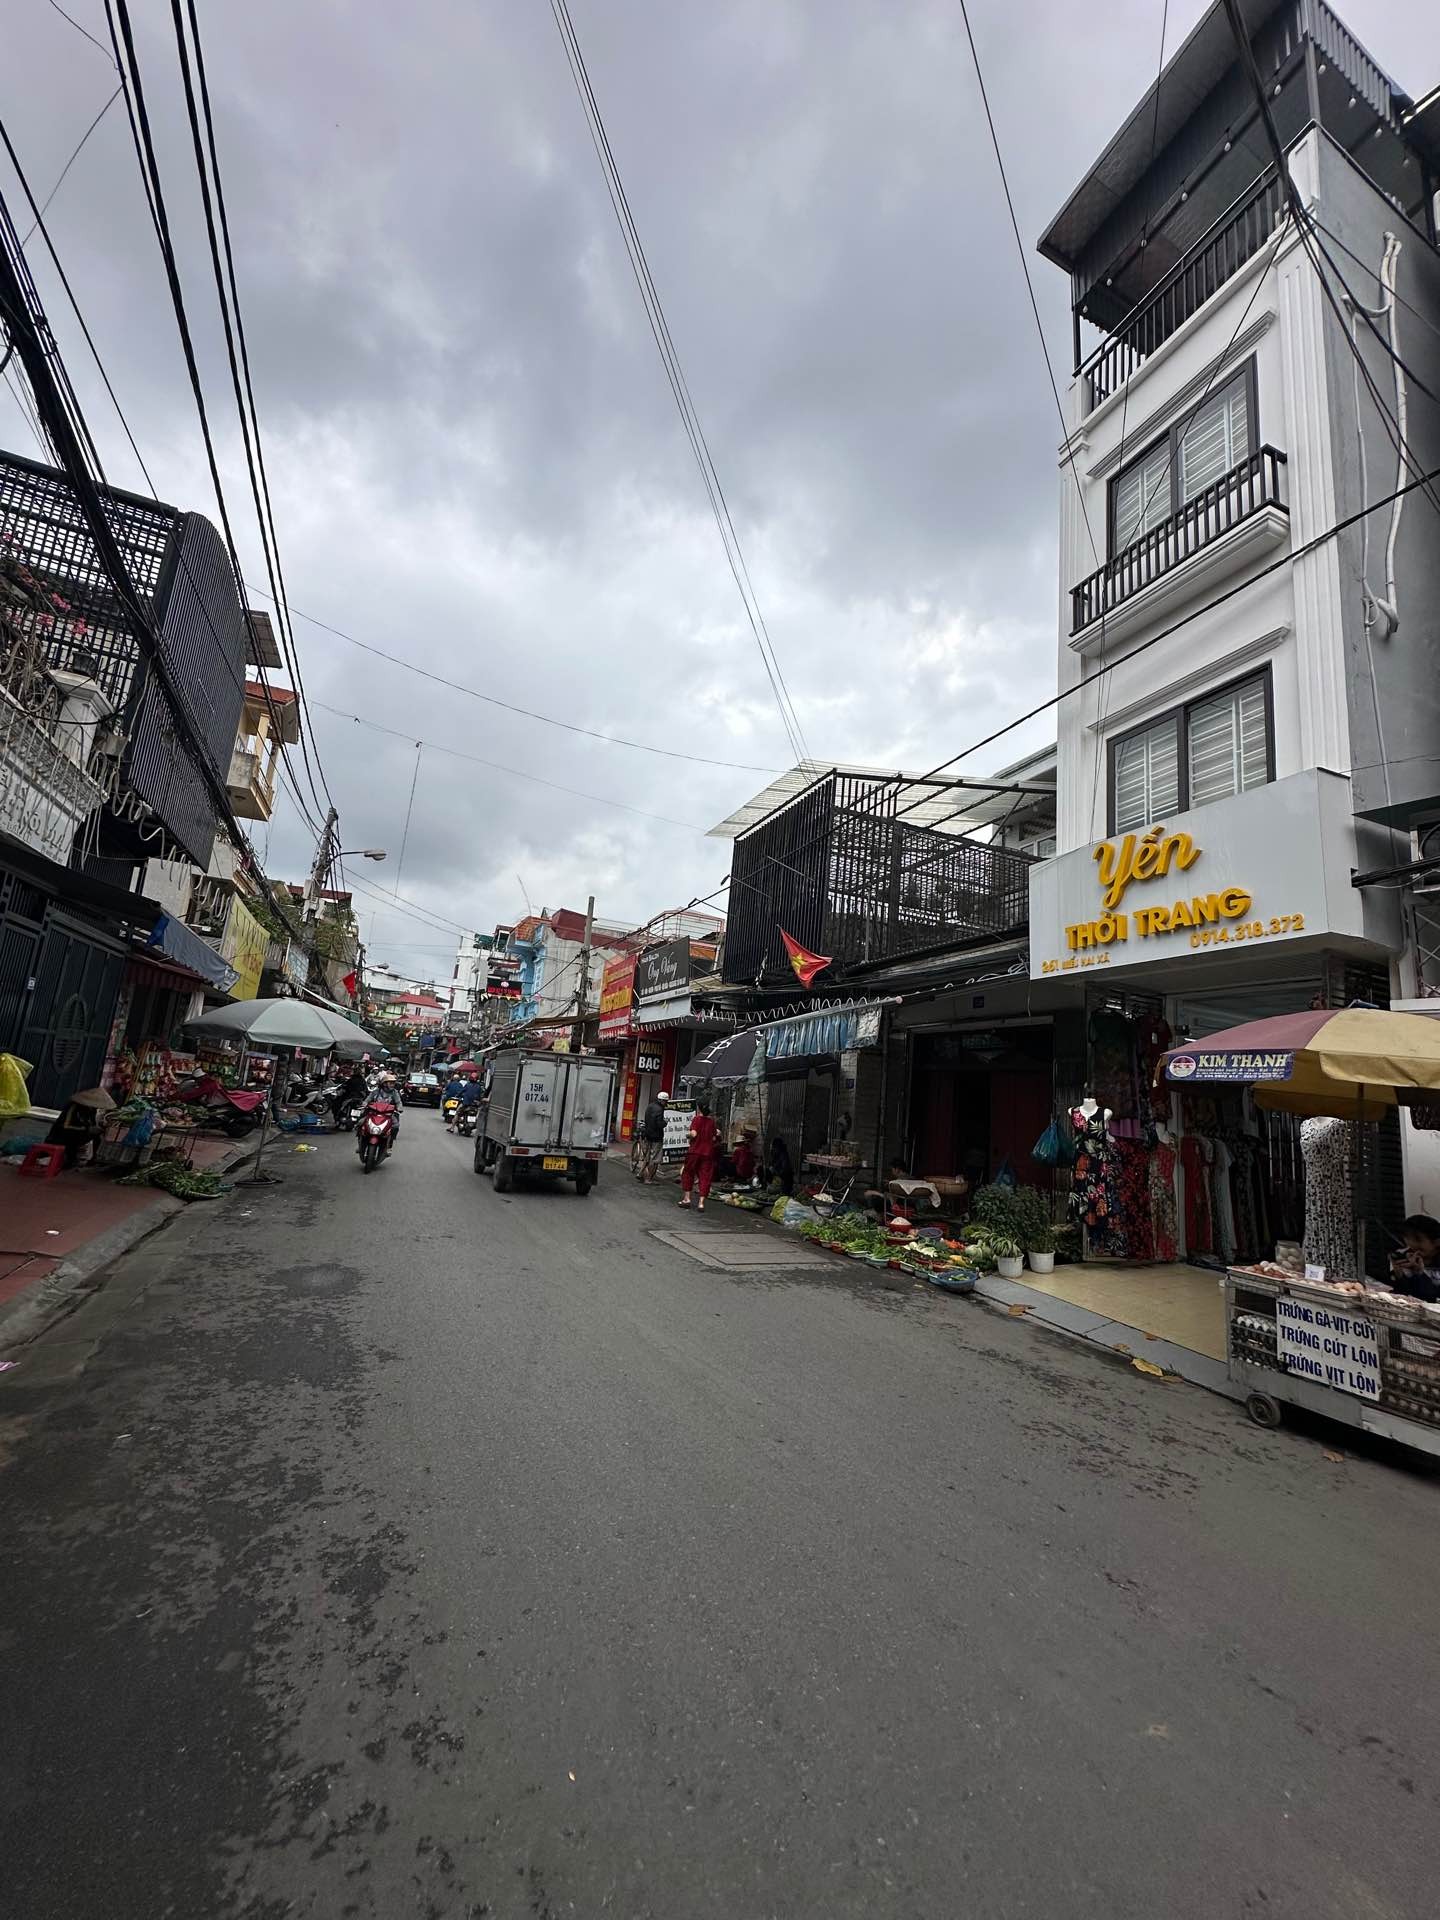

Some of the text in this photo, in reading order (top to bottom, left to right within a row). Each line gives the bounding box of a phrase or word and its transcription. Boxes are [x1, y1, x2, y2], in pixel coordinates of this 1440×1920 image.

[1093, 825, 1204, 910] Yến
[1064, 887, 1253, 951] THỜI TRANG
[1190, 912, 1305, 949] 0914.318.372
[638, 1056, 661, 1072] BẠC
[1198, 1053, 1288, 1068] KIM THANH
[530, 1083, 544, 1092] 15H
[1277, 1301, 1314, 1324] TRỨNG
[1280, 1325, 1378, 1369] TRỨNG CÚT LỘN
[1281, 1351, 1377, 1395] TRỨNG VỊT LỘN
